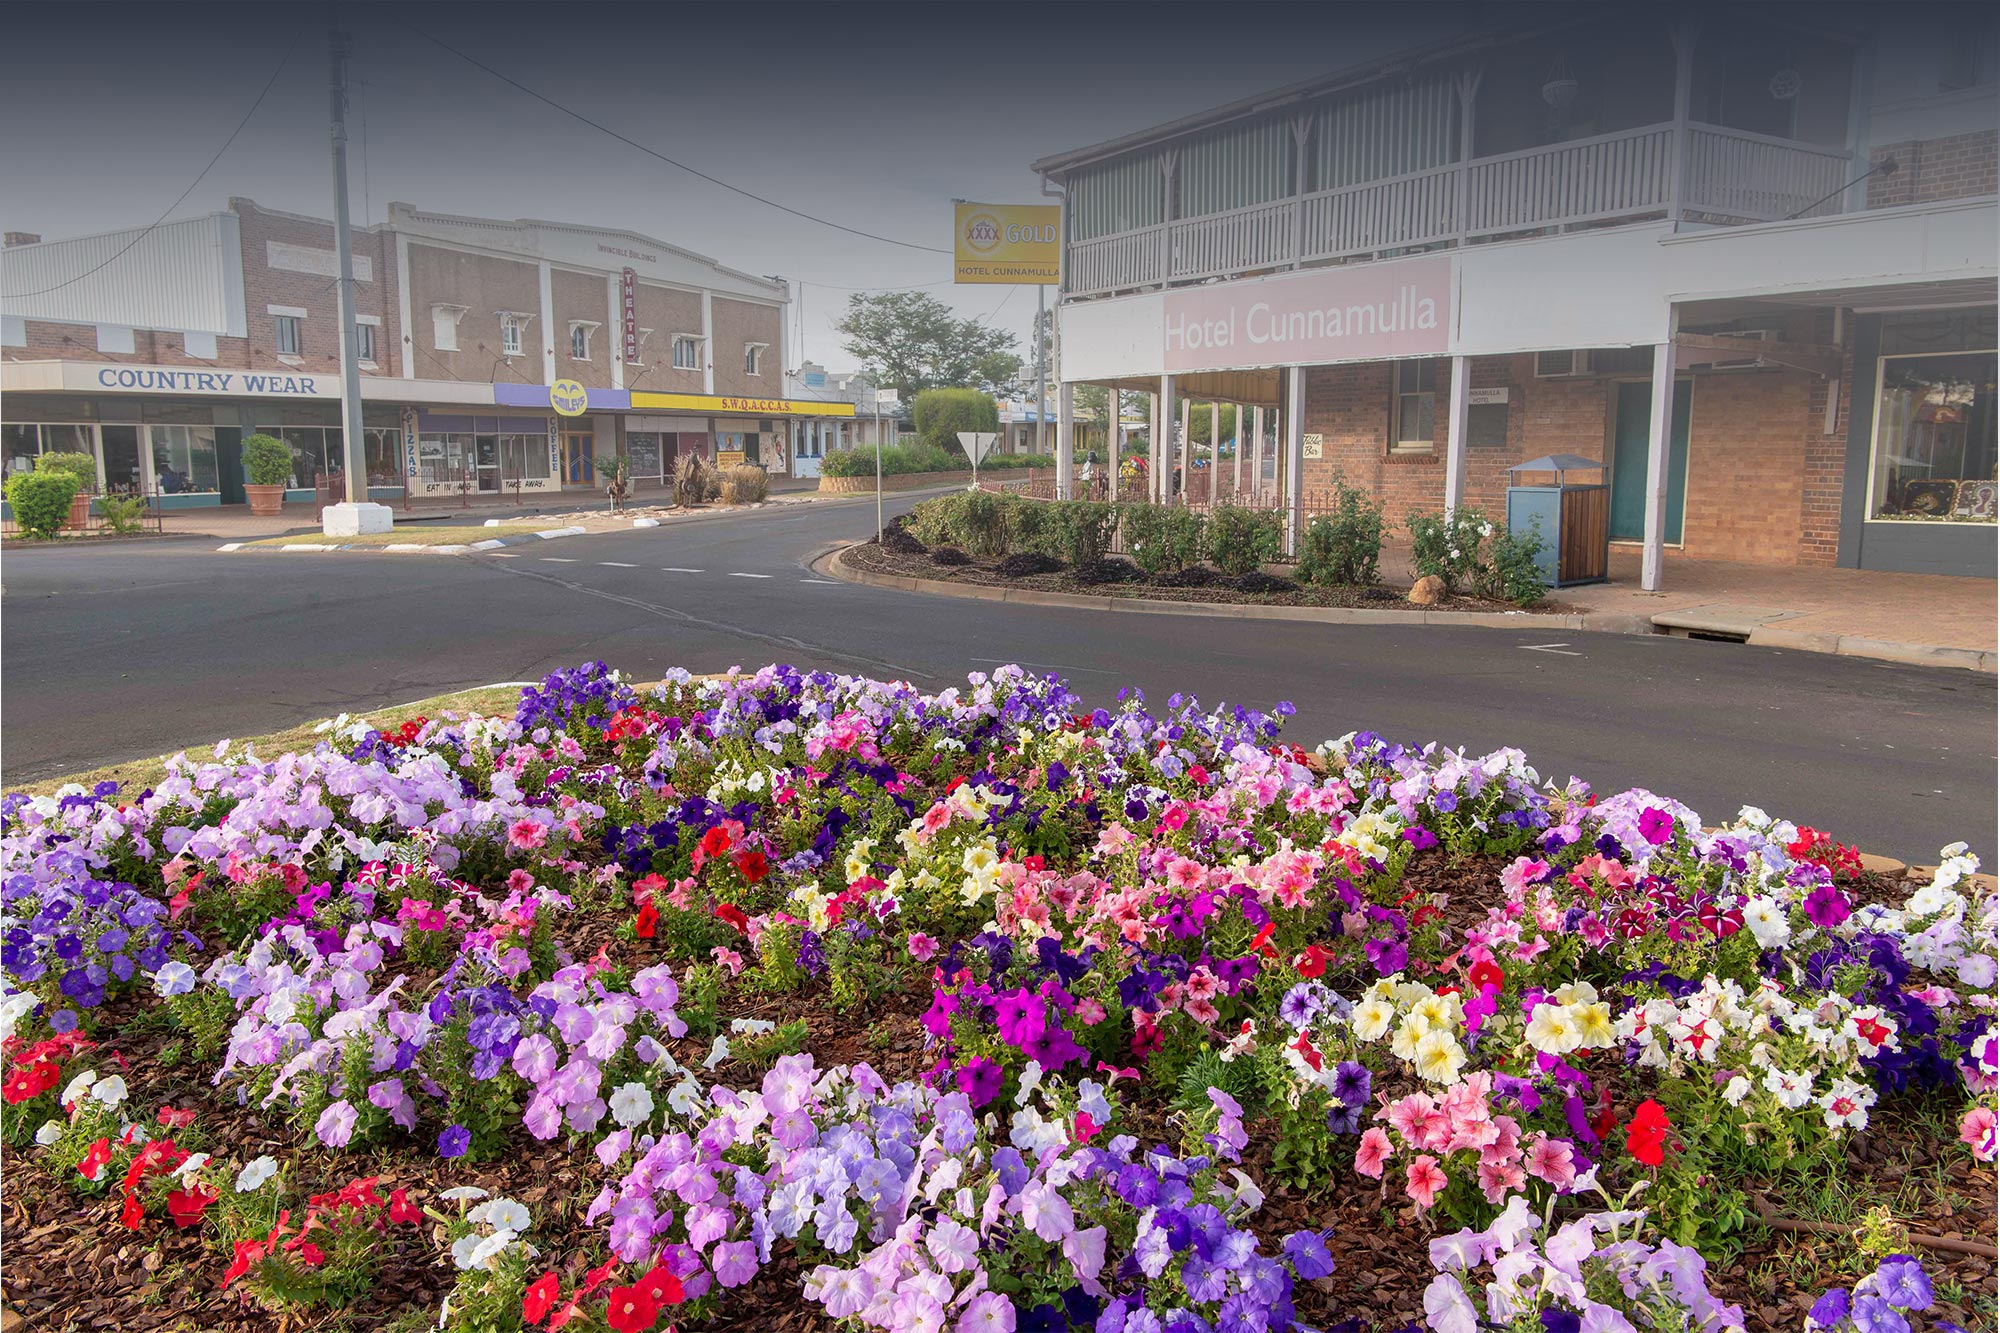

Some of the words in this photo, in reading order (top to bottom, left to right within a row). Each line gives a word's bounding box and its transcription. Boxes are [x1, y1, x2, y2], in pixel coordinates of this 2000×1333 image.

[967, 227, 1001, 241] XXXX
[1005, 223, 1057, 244] GOLD
[958, 267, 990, 276] HOTEL
[992, 267, 1060, 277] CUNNAMULLA
[624, 273, 636, 356] THEATRE
[1165, 305, 1236, 352] Hotel
[1246, 285, 1438, 344] Cunnamulla
[98, 368, 233, 391] COUNTRY
[243, 375, 318, 394] WEAR
[721, 399, 792, 412] S.W.Q.A.C.C.A.S.
[406, 413, 417, 477] PIZZAS
[549, 416, 559, 471] COFFEE
[426, 483, 440, 492] EAT
[444, 483, 451, 491] IN
